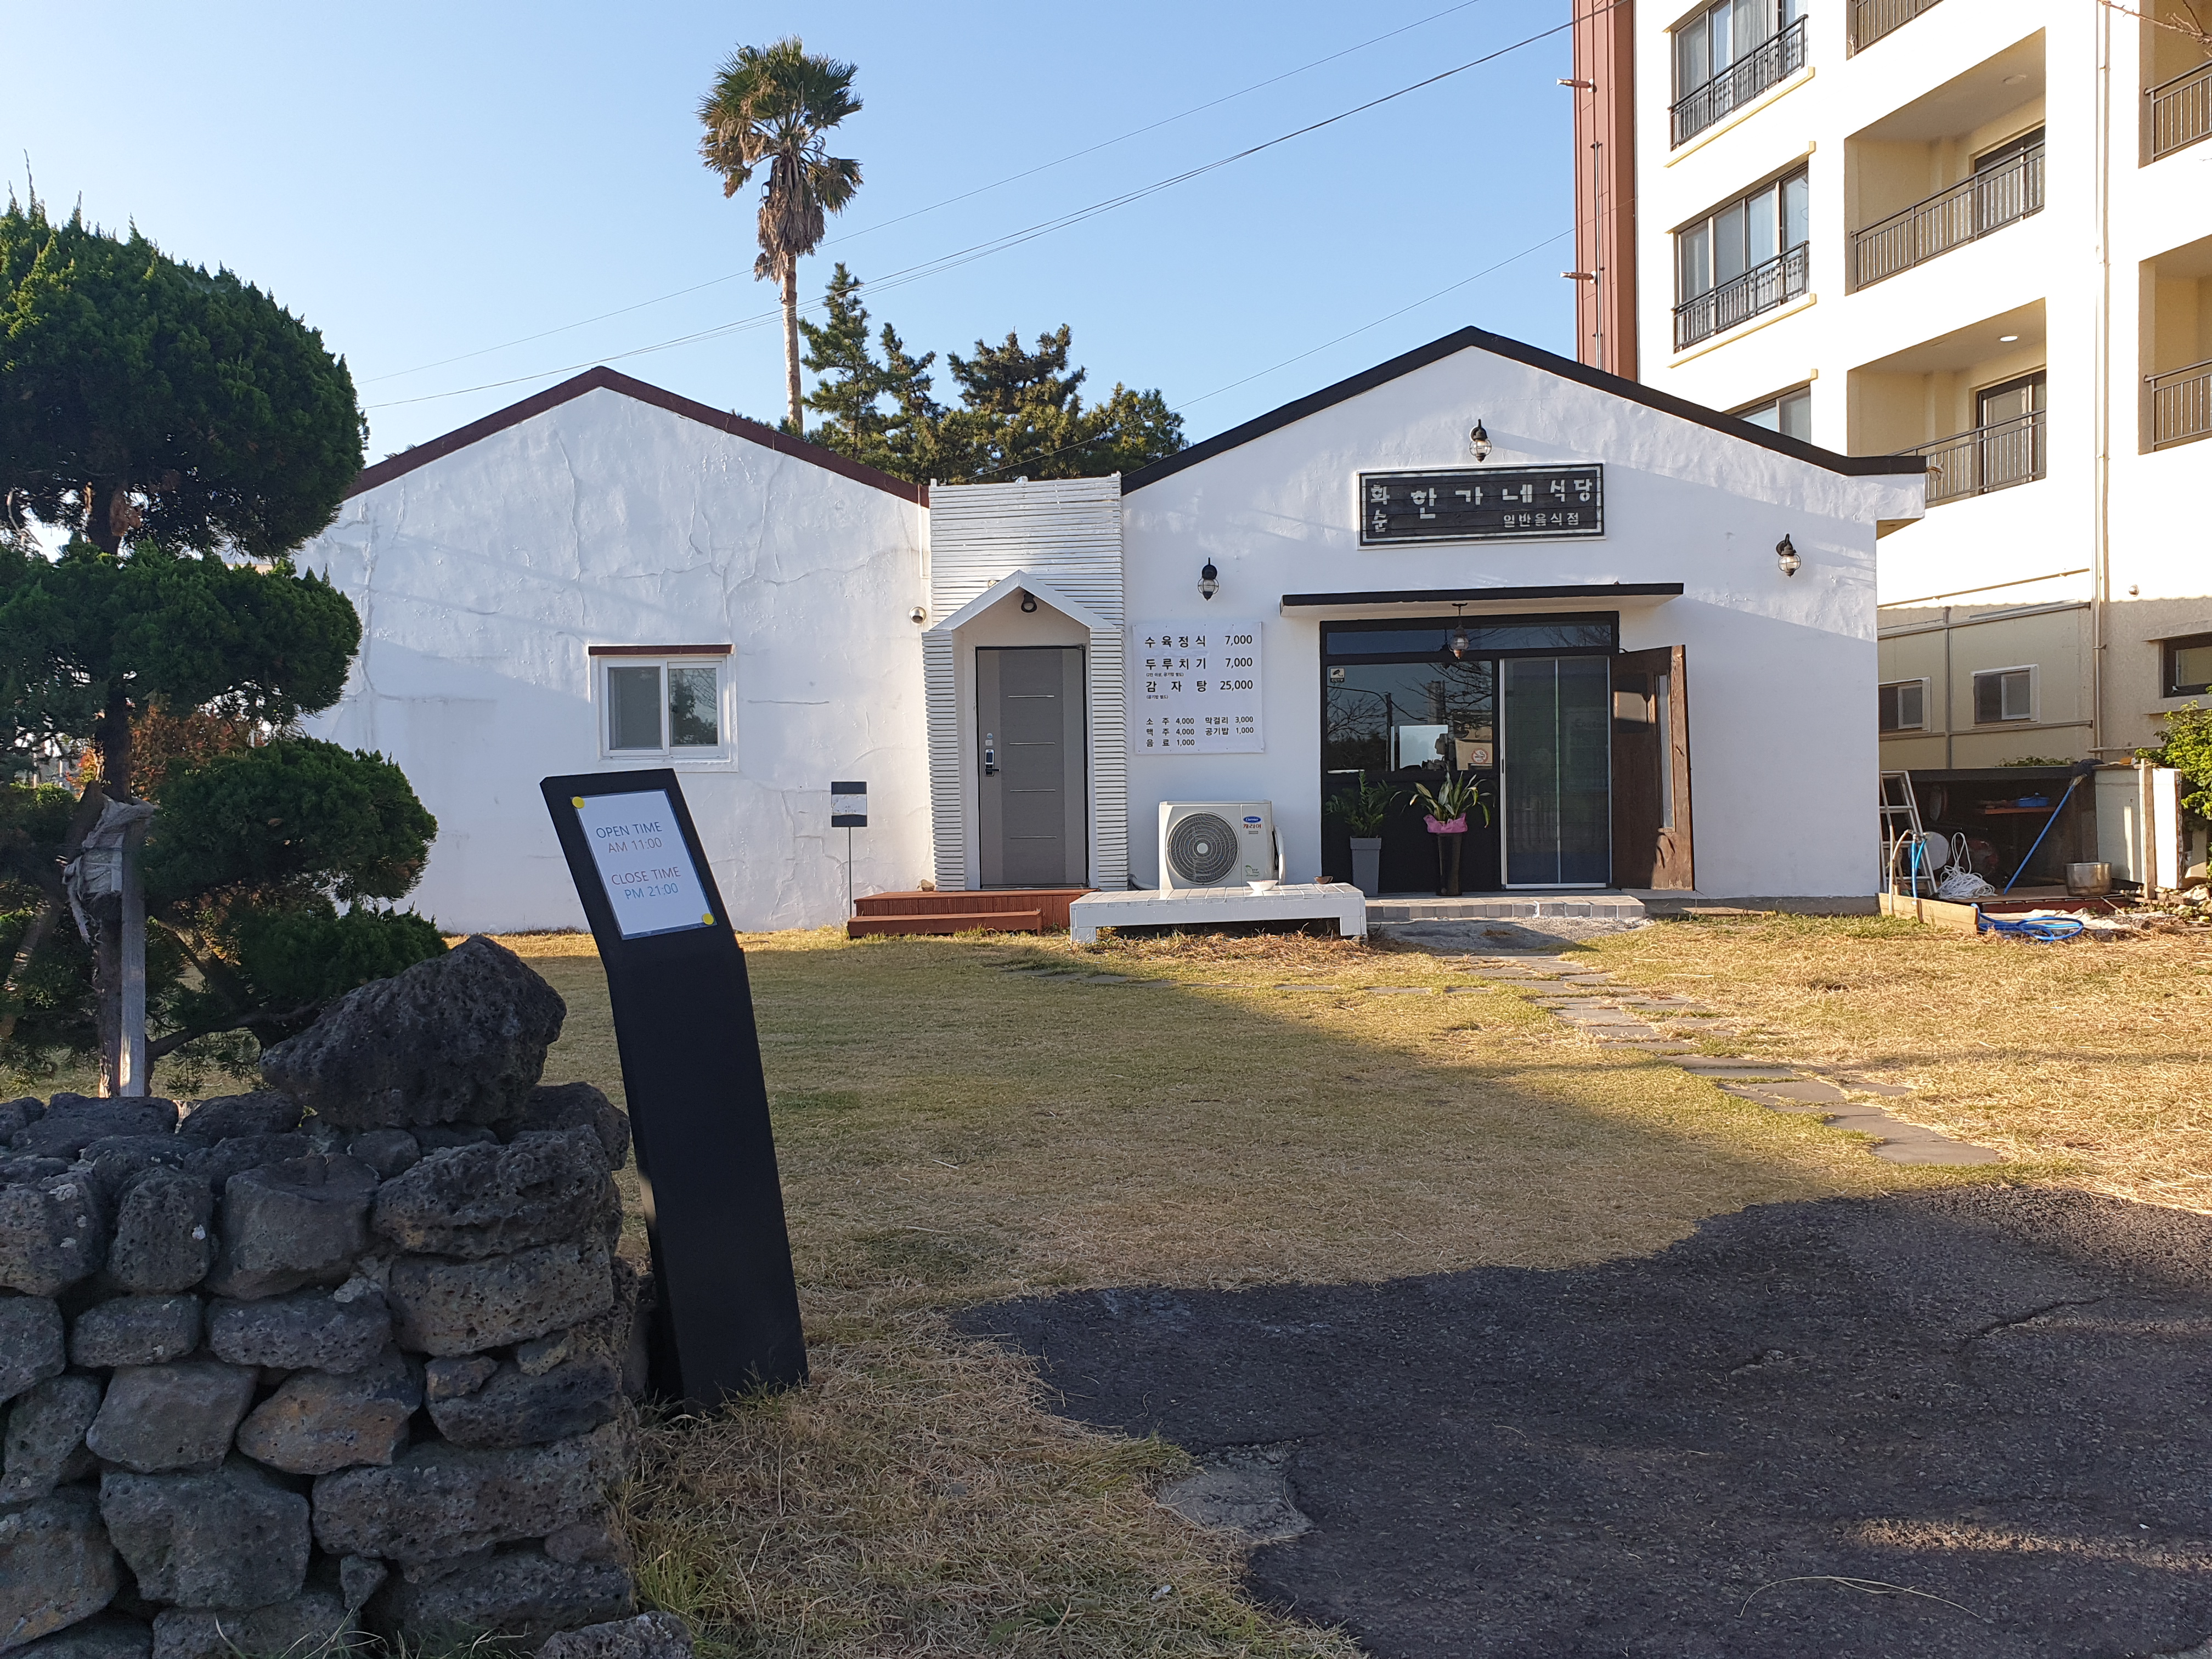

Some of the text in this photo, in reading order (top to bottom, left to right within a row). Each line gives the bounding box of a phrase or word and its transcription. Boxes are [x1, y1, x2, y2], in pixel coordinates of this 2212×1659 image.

[1503, 511, 1580, 528] 일반음식점
[1224, 635, 1252, 646] 7,000
[1224, 657, 1253, 669] 7,000
[1220, 680, 1253, 691] 25,000
[1205, 716, 1229, 725] 막걸리
[1205, 727, 1229, 736] 공기밥
[596, 821, 663, 839] OPEN TIME
[608, 837, 662, 854] AM 11:00
[611, 866, 681, 885] CLOSE TIME
[624, 882, 679, 900] PM 21:00
